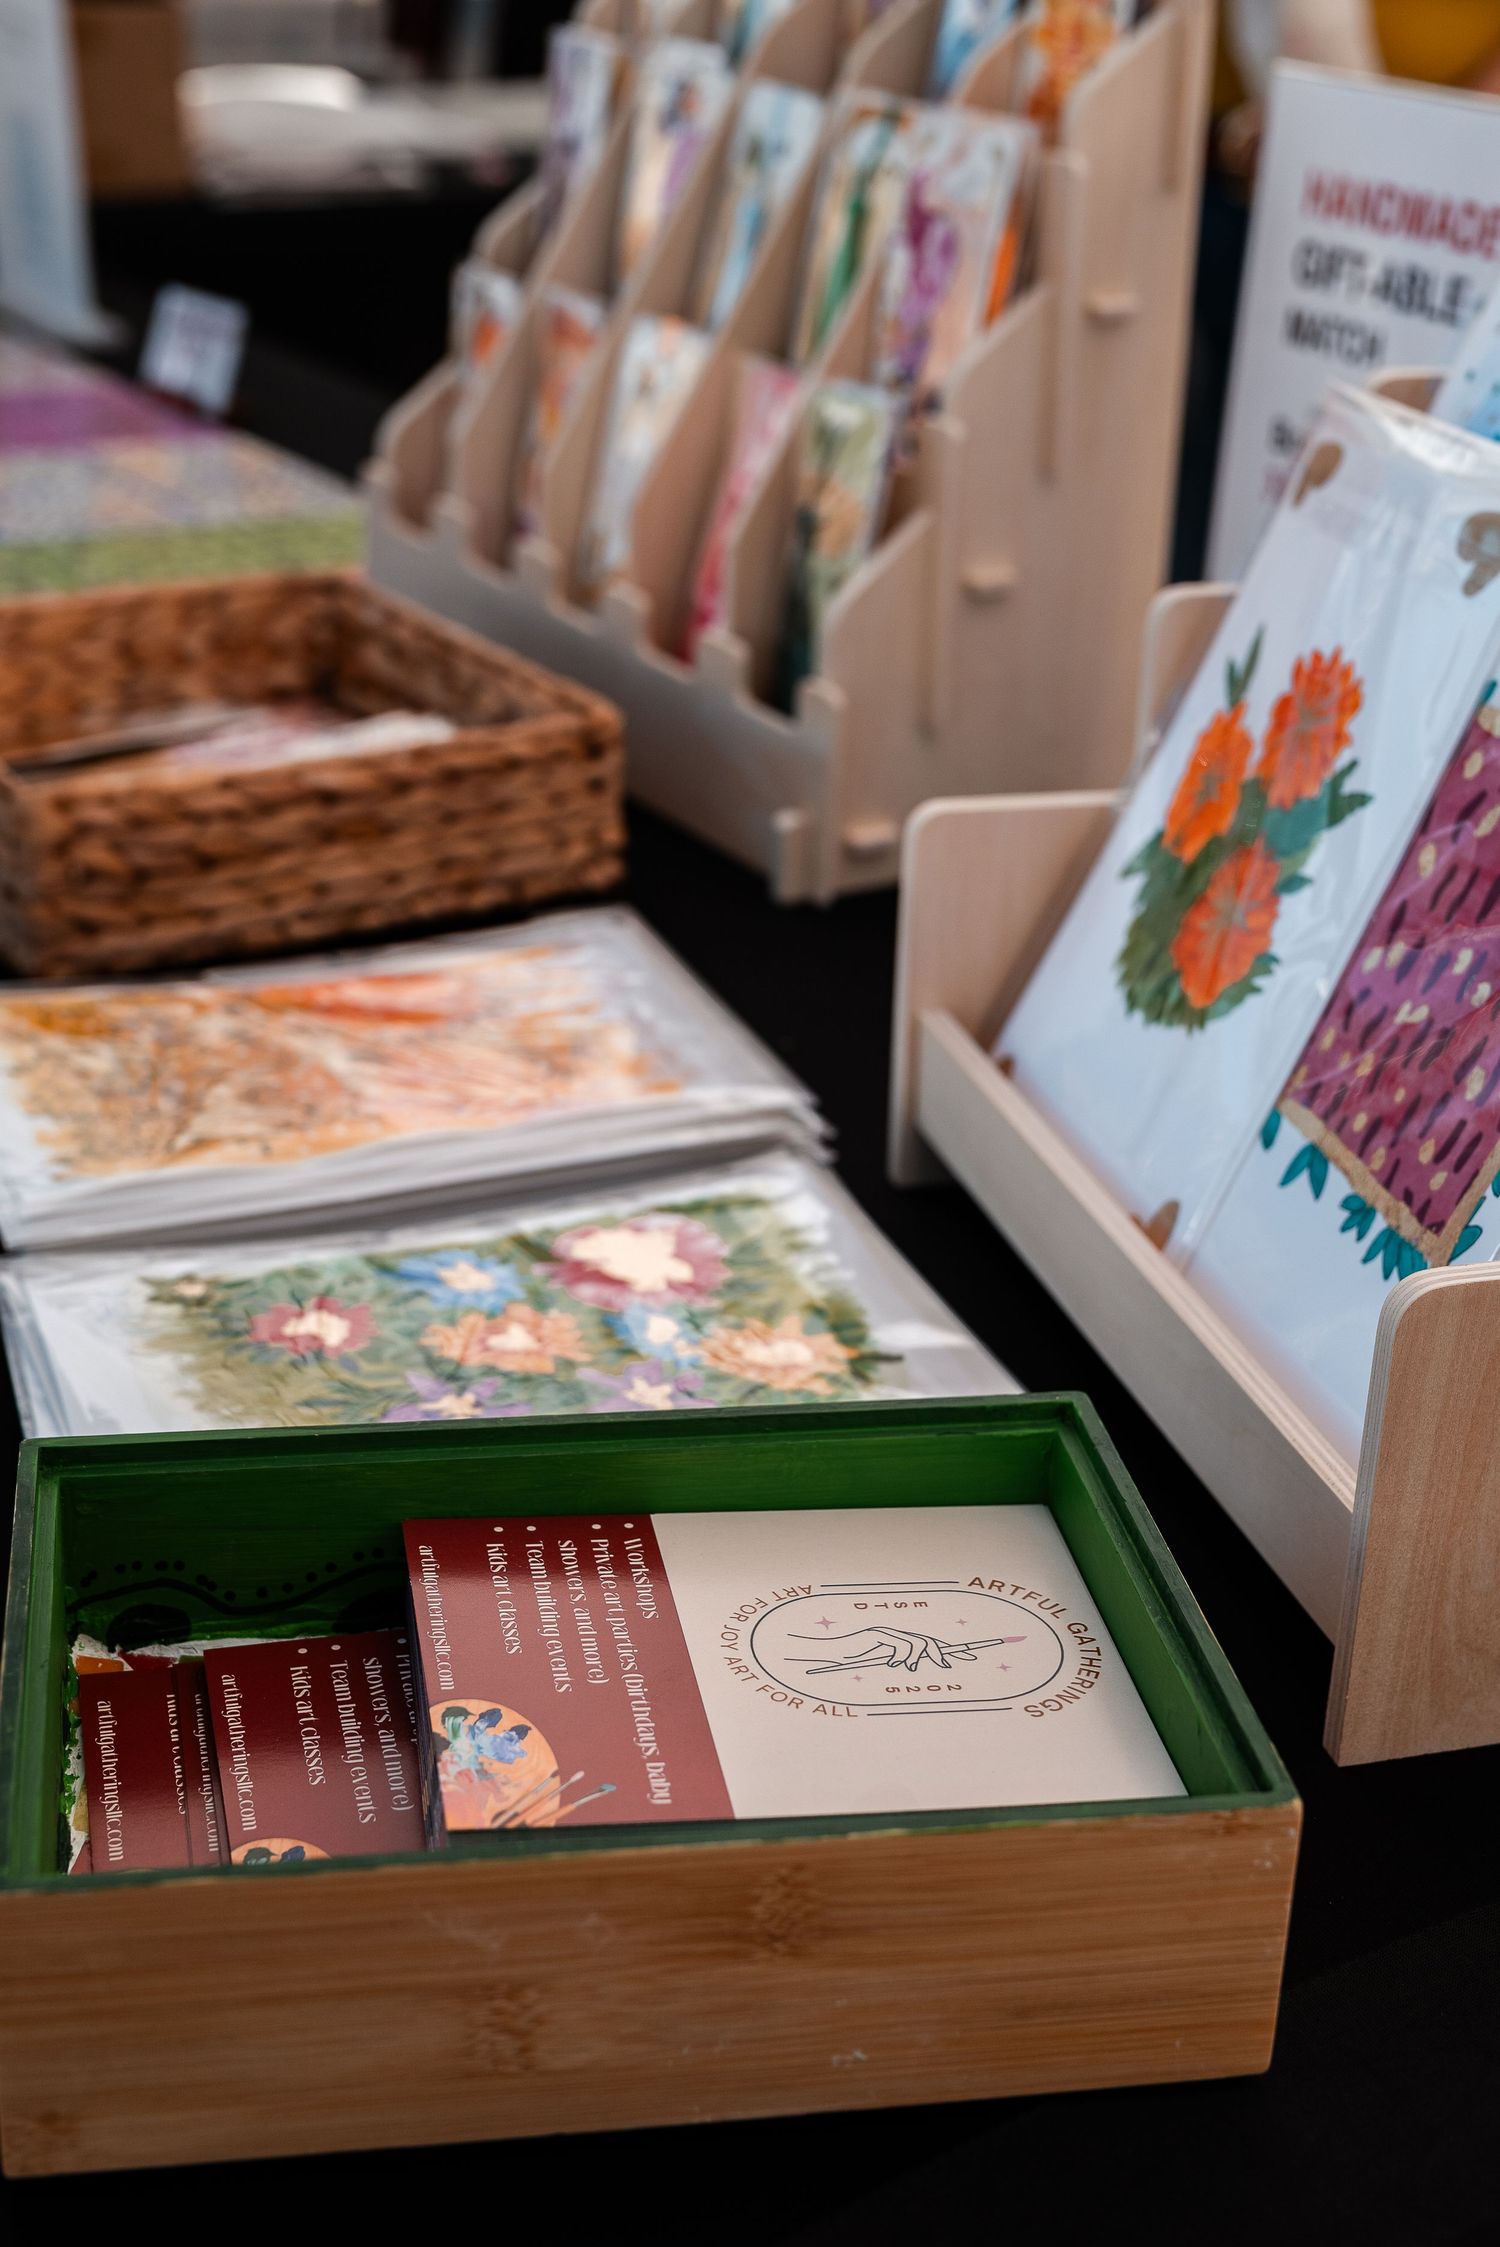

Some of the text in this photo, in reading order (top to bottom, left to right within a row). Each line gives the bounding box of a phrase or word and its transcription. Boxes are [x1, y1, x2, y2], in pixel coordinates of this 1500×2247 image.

[418, 1545, 455, 1690] artfulgatheringsllc.com
[486, 1542, 523, 1655] Kids art classes
[525, 1540, 574, 1694] Team building events
[557, 1539, 610, 1686] showers, and more)
[623, 1537, 659, 1620] Workshops
[720, 1584, 859, 1718] ART FOR JOY ART FOR ALL
[854, 1601, 928, 1611] ESTD
[967, 1576, 1103, 1719] ARTFUL GATHERINGS
[289, 1665, 327, 1786] Kids art classes
[329, 1659, 377, 1825] Team building events
[362, 1656, 416, 1813] showers, and more)
[591, 1538, 673, 1805] Private art parties (birthdays, baby
[886, 1684, 962, 1694] 2025
[95, 1700, 125, 1862] artfulgatheringsllc.com
[220, 1673, 258, 1832] artfulgatheringsllc.com
